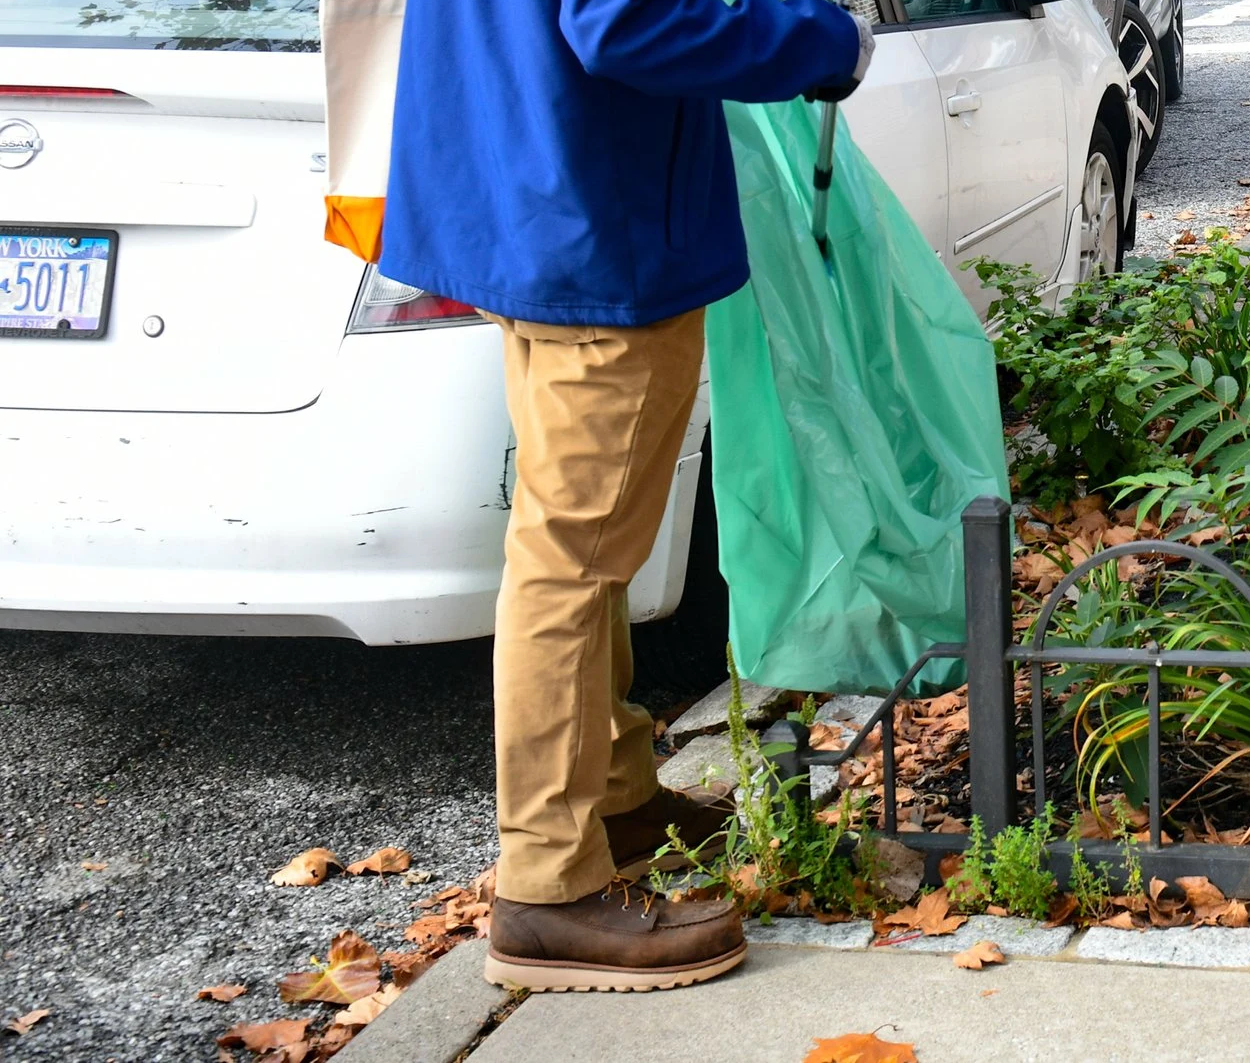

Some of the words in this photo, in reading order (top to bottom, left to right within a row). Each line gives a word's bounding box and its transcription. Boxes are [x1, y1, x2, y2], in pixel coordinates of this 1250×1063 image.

[0, 139, 34, 148] SSAN
[0, 237, 13, 257] W
[18, 237, 68, 258] YORK
[13, 260, 89, 313] 5011
